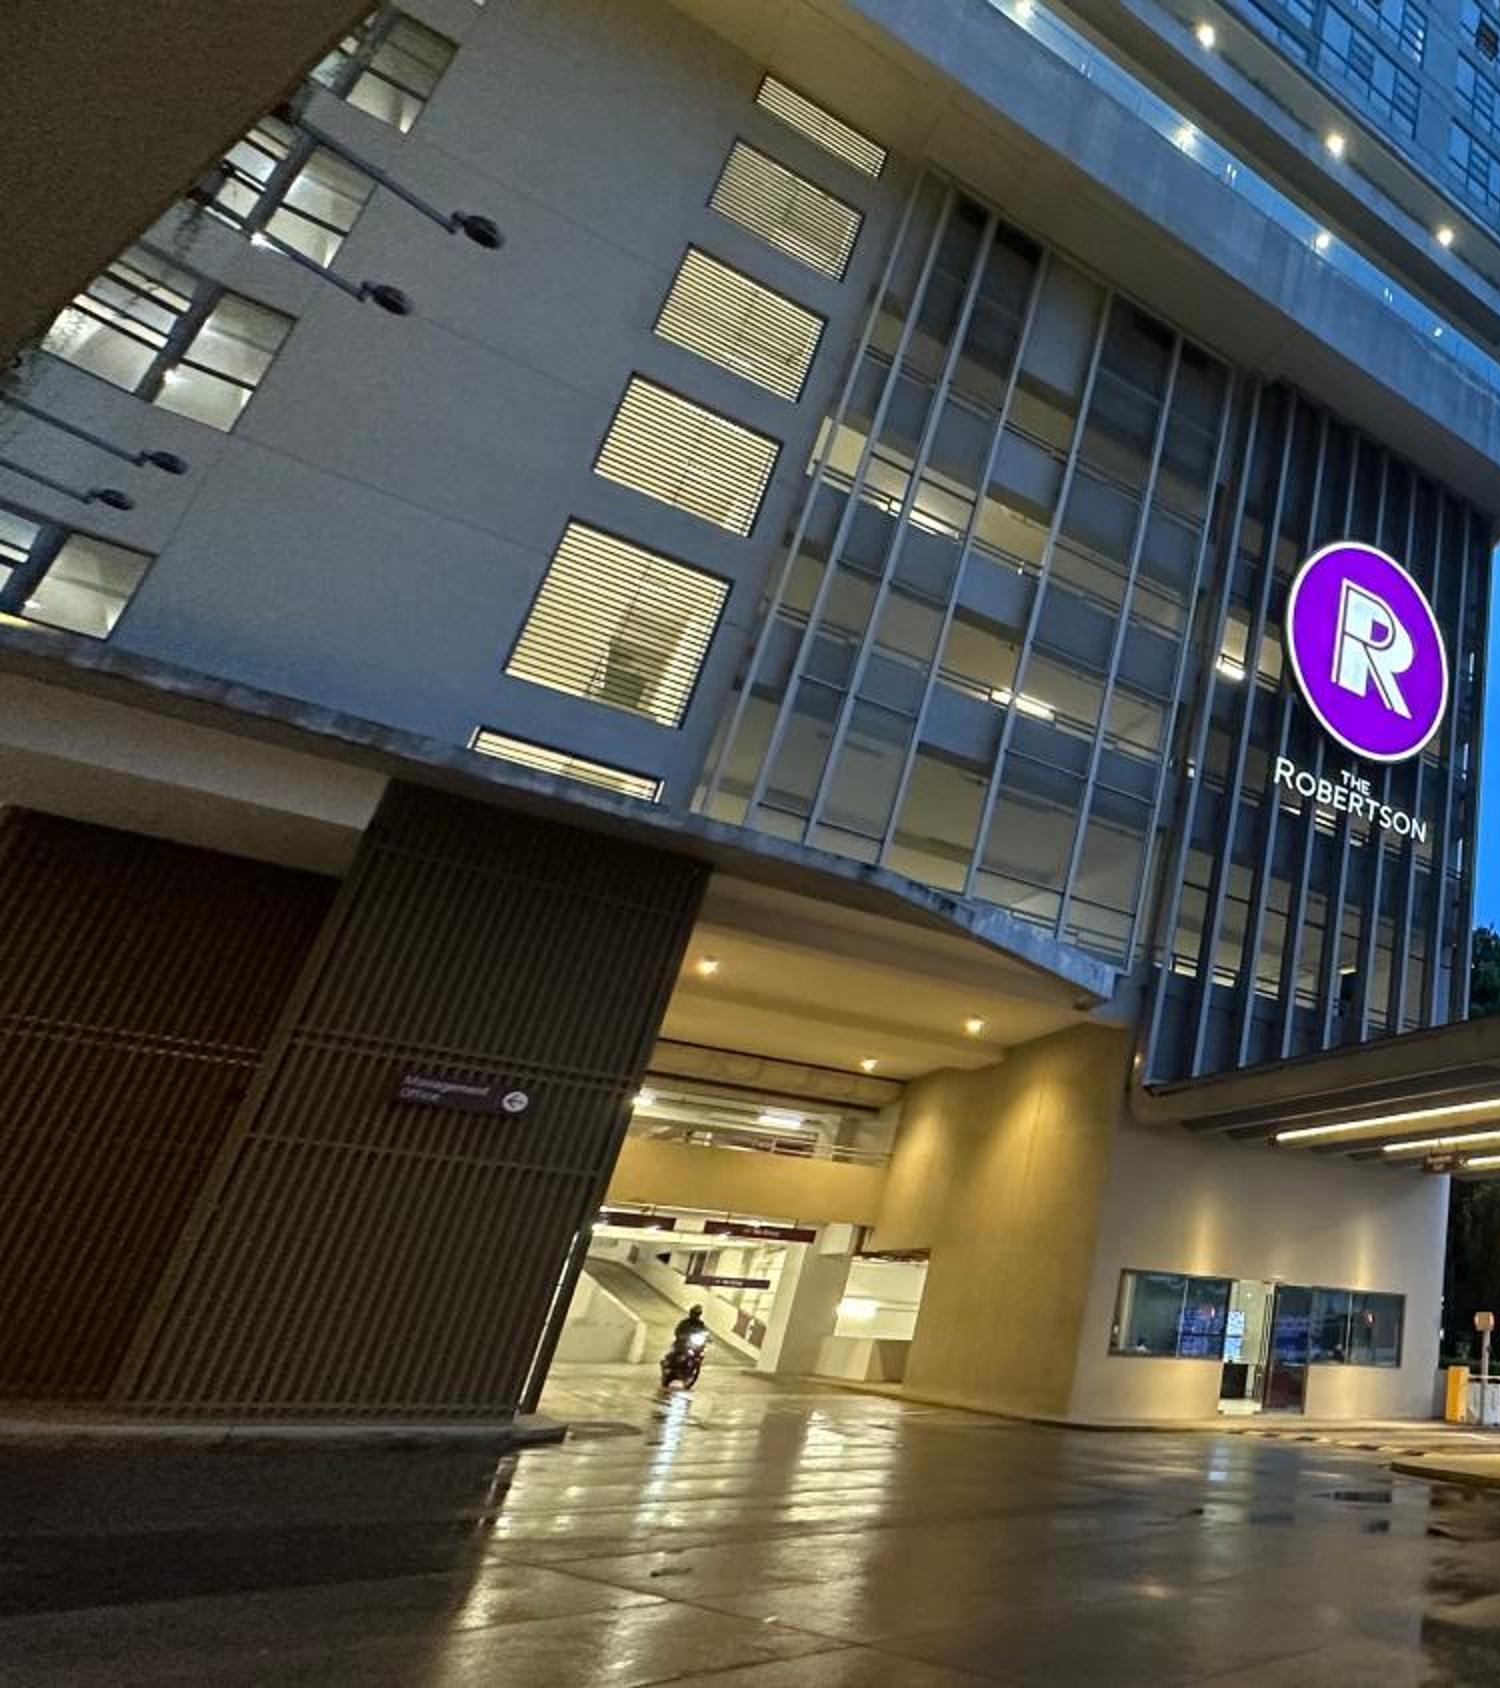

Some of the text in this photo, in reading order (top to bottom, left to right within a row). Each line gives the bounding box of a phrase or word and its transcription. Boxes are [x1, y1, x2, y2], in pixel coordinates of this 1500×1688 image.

[1331, 577, 1415, 719] R
[1274, 756, 1427, 843] ROBERTSON
[1341, 769, 1371, 796] THE
